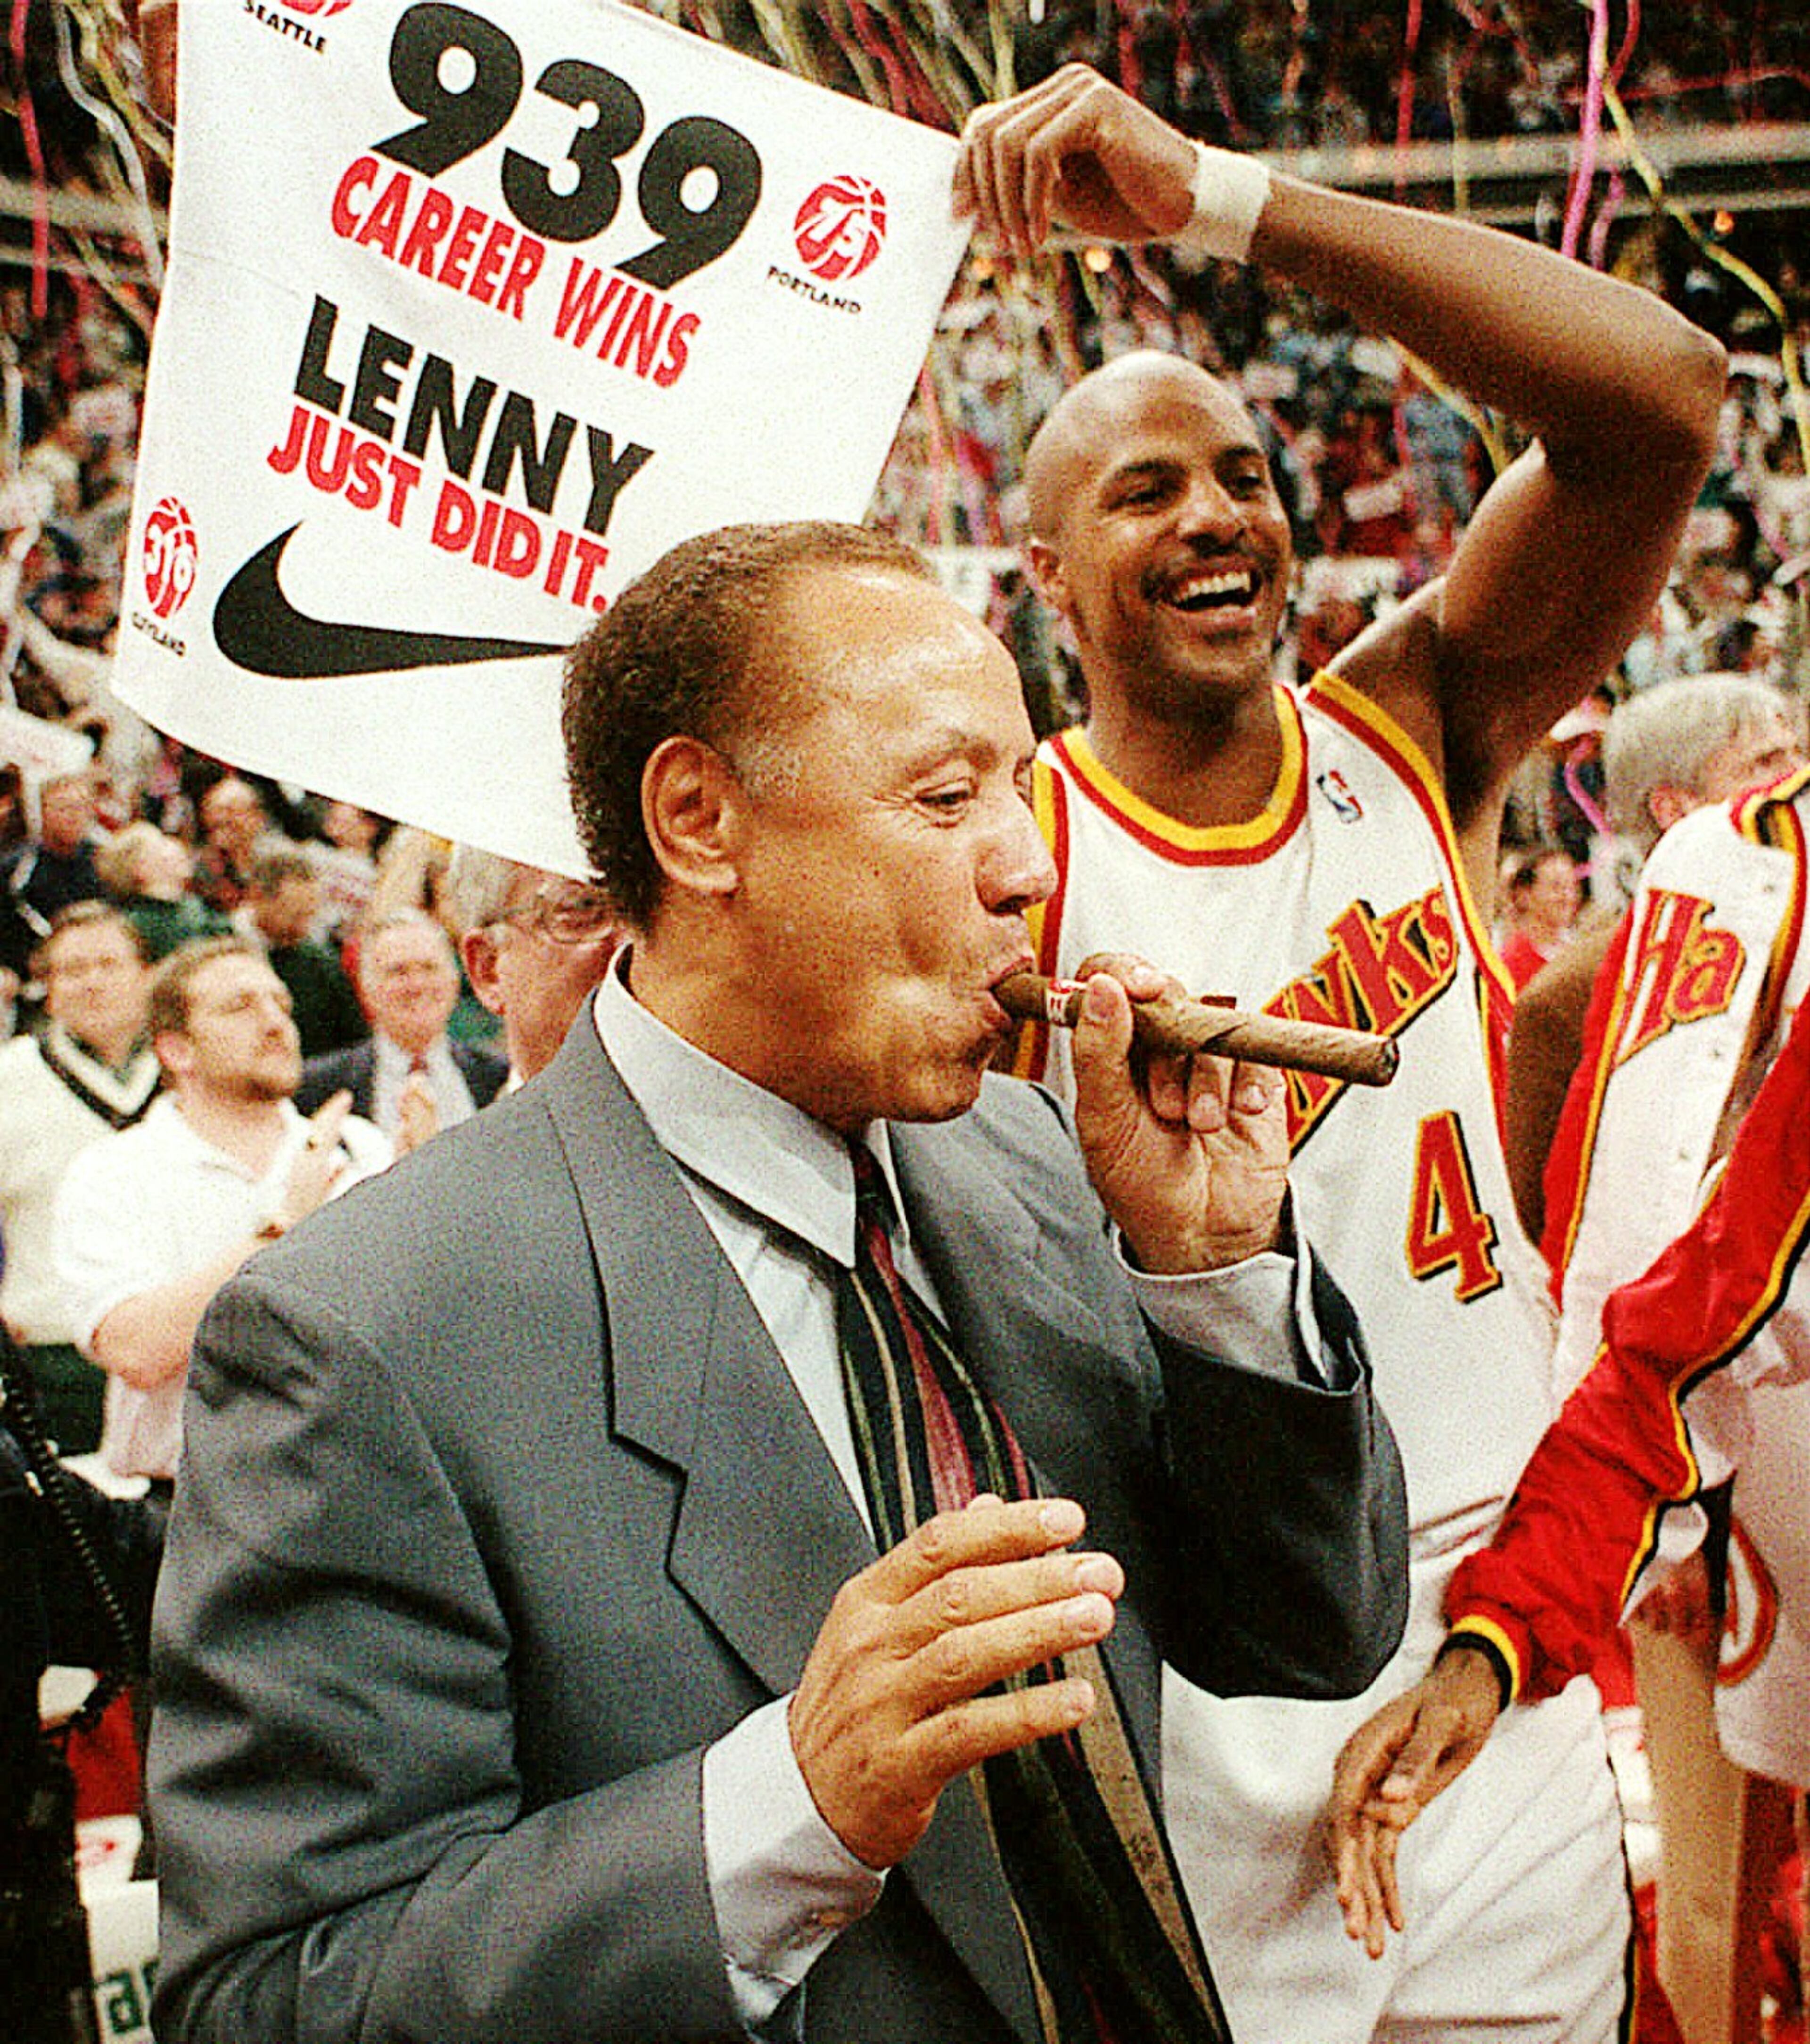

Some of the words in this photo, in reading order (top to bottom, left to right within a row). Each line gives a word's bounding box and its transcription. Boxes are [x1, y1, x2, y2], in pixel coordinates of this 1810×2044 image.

[243, 0, 326, 53] SEATTLE
[369, 2, 763, 291] 939
[331, 156, 546, 321] CAREER
[554, 257, 701, 387] WINS
[767, 265, 862, 313] PORTLAND
[267, 405, 422, 528] JUST
[431, 480, 542, 580] DID
[543, 530, 609, 614] IT.
[294, 294, 654, 536] LENNY
[1405, 1109, 1504, 1304] 4
